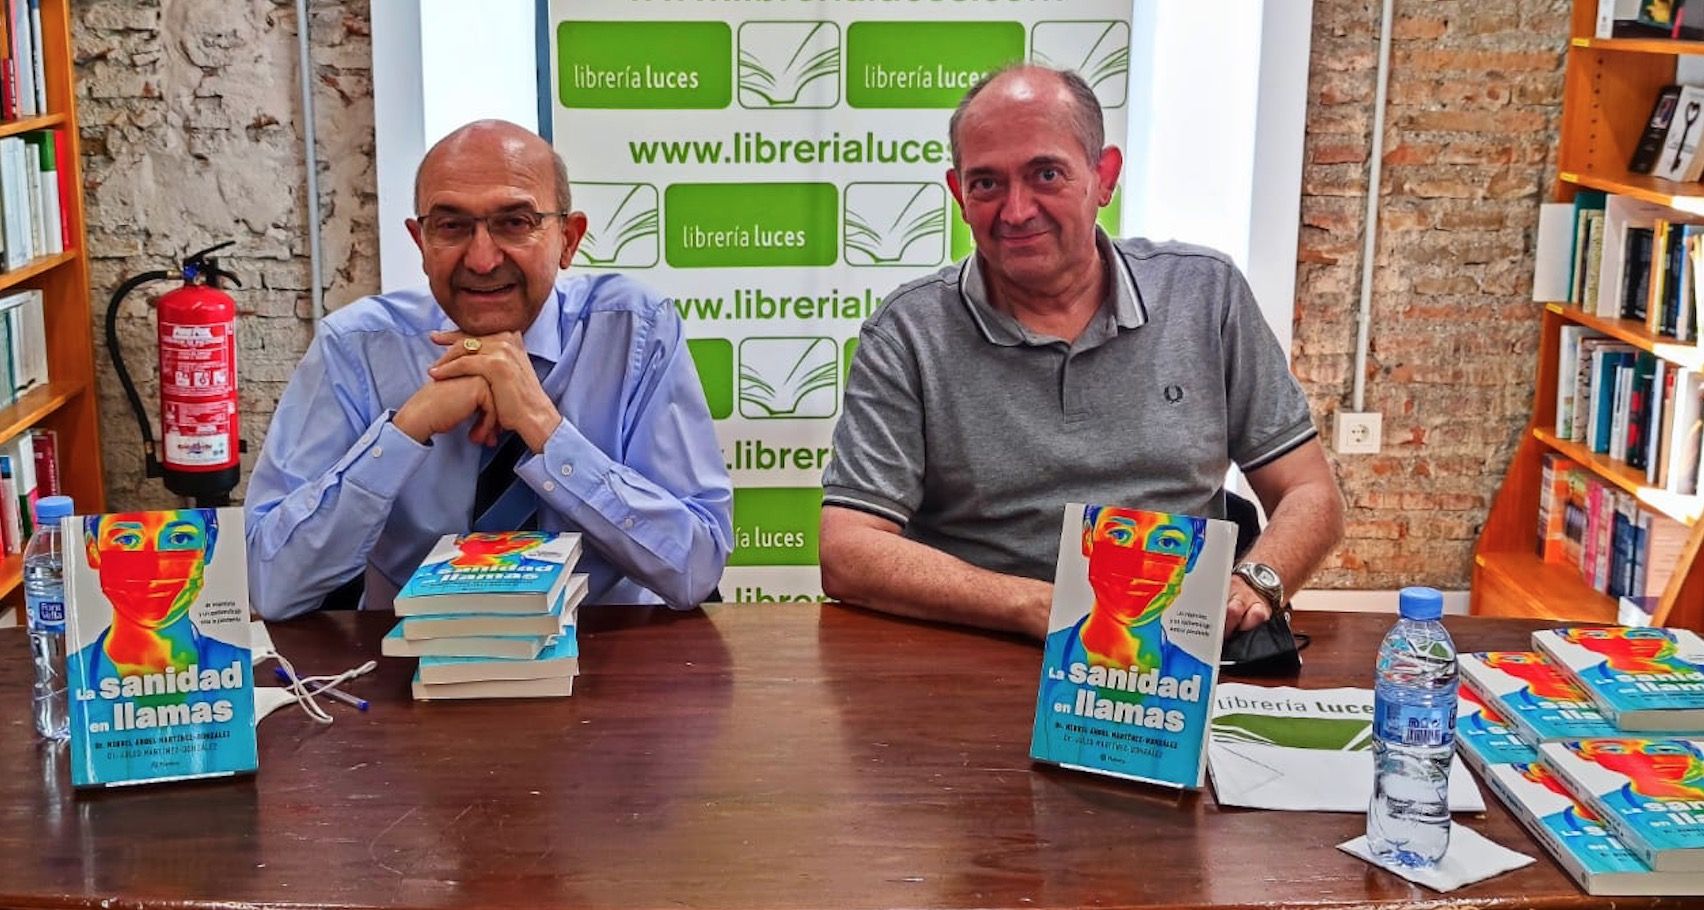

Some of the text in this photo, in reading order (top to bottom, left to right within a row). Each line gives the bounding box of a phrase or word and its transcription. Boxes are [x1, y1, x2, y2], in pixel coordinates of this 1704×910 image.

[574, 65, 699, 88] librería luces
[865, 64, 932, 89] librería
[629, 131, 953, 164] www.librerialuce
[683, 224, 806, 248] librería luces
[755, 526, 805, 547] luces
[76, 660, 243, 700] La sanidad
[1048, 662, 1202, 703] La sanidad
[89, 700, 234, 733] en llamas
[1054, 688, 1186, 733] en llamas
